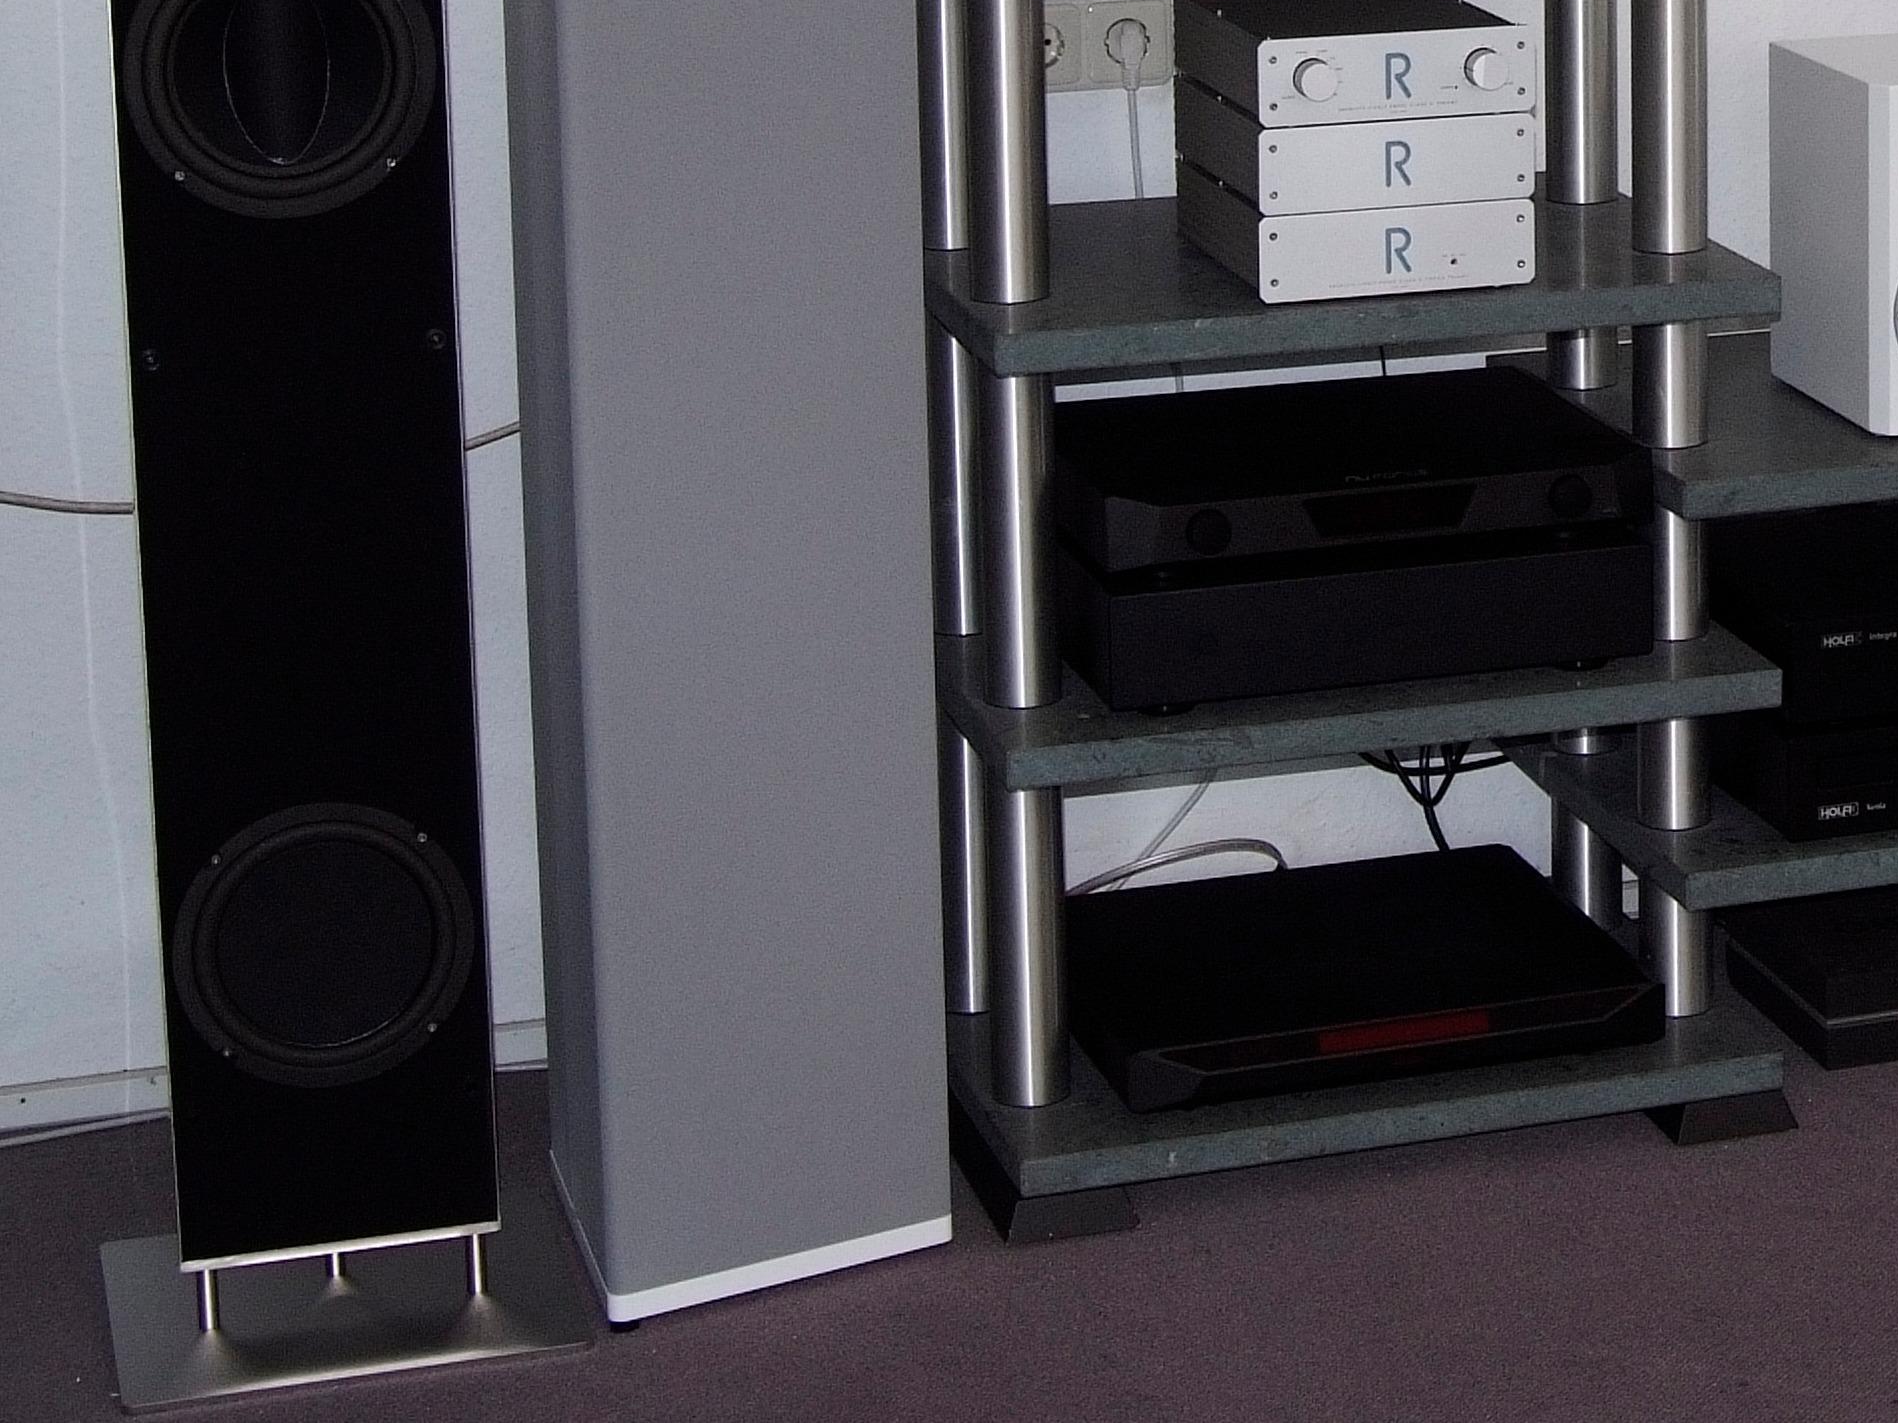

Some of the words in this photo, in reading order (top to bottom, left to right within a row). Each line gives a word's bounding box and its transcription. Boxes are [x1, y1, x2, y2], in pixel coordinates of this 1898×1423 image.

[1384, 51, 1413, 101] R
[1384, 140, 1413, 188] R
[1384, 226, 1413, 276] R
